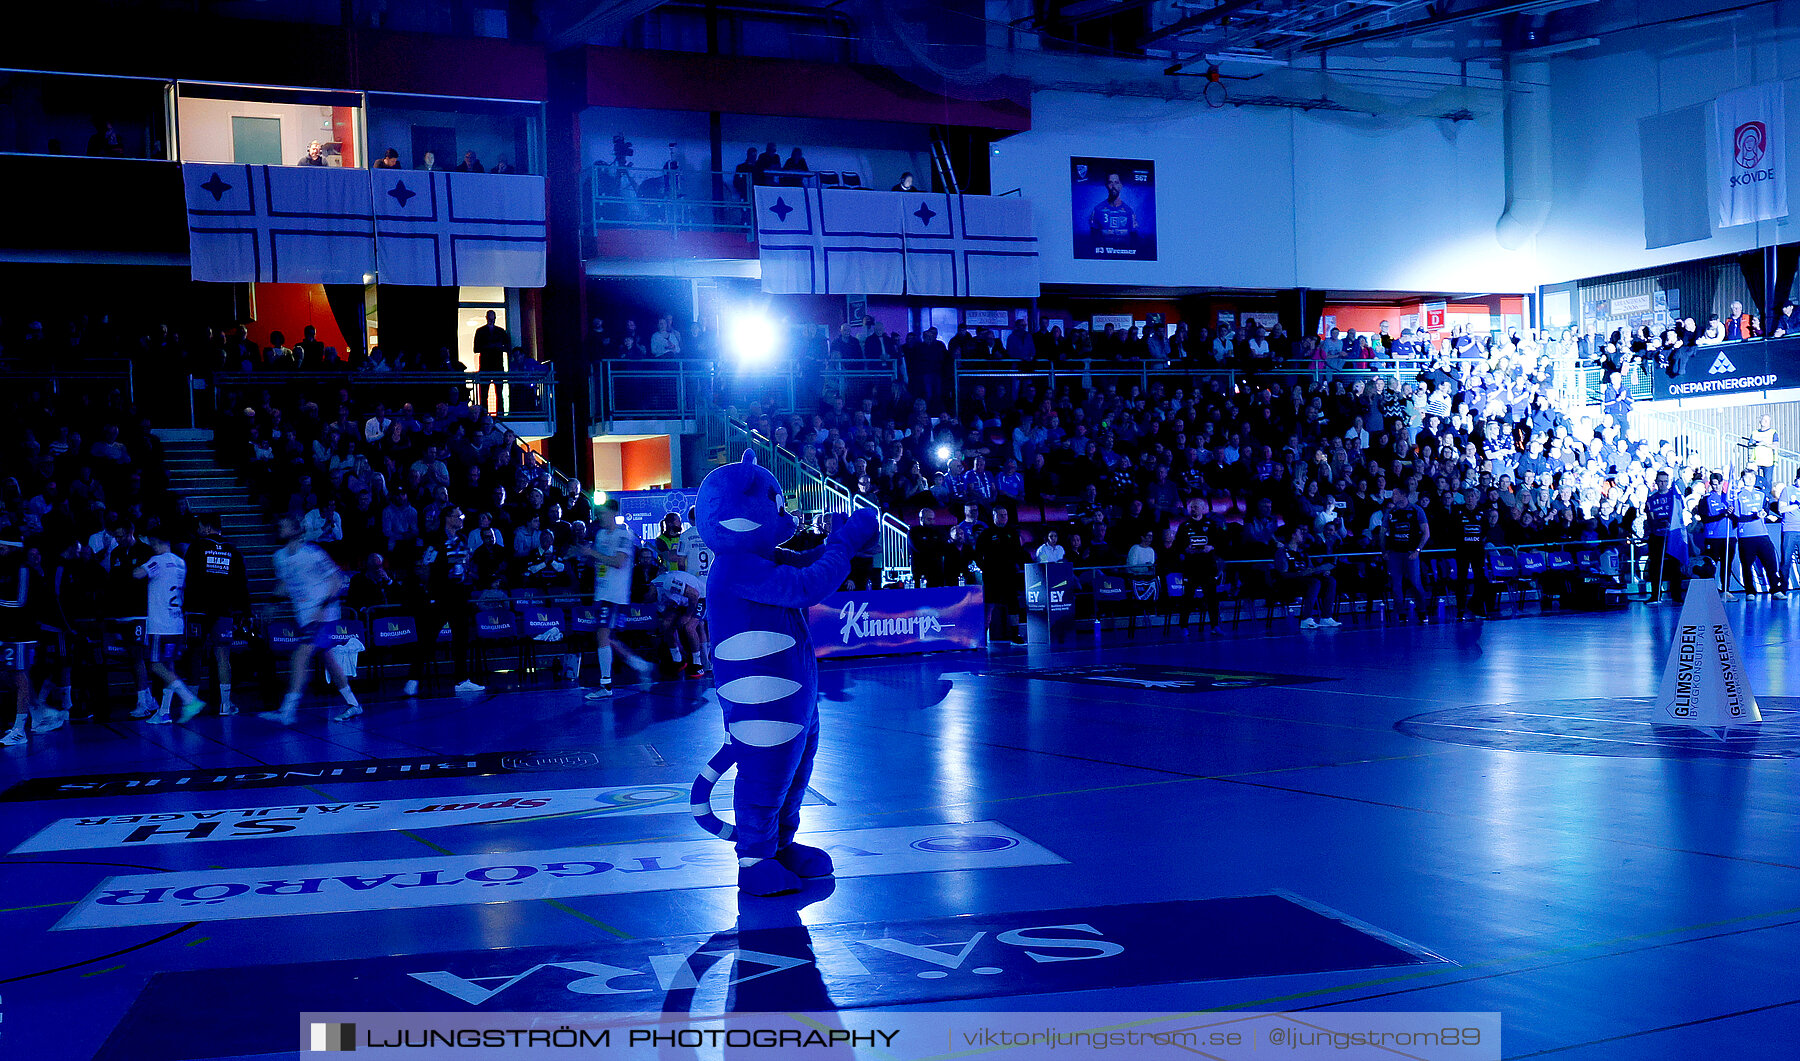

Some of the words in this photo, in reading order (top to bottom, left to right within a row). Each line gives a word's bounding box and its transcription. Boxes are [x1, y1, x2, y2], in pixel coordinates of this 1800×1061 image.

[1729, 167, 1775, 189] SKÖVDE
[1431, 315, 1440, 325] D
[1668, 374, 1778, 395] ONEPARTNERGROUP
[698, 551, 709, 569] 9
[1028, 590, 1040, 603] EY
[1050, 590, 1065, 603] EY
[135, 625, 143, 637] 8
[839, 600, 955, 644] Kinnarps
[4, 648, 14, 660] 2
[1674, 625, 1697, 717] GLIMSVEDEN
[1689, 642, 1704, 717] BYGGKONSULT
[1698, 624, 1706, 639] AB
[1713, 624, 1741, 716] GLIMSVEDEN
[75, 802, 381, 826] SÄLJLAGER
[121, 817, 304, 843] SH
